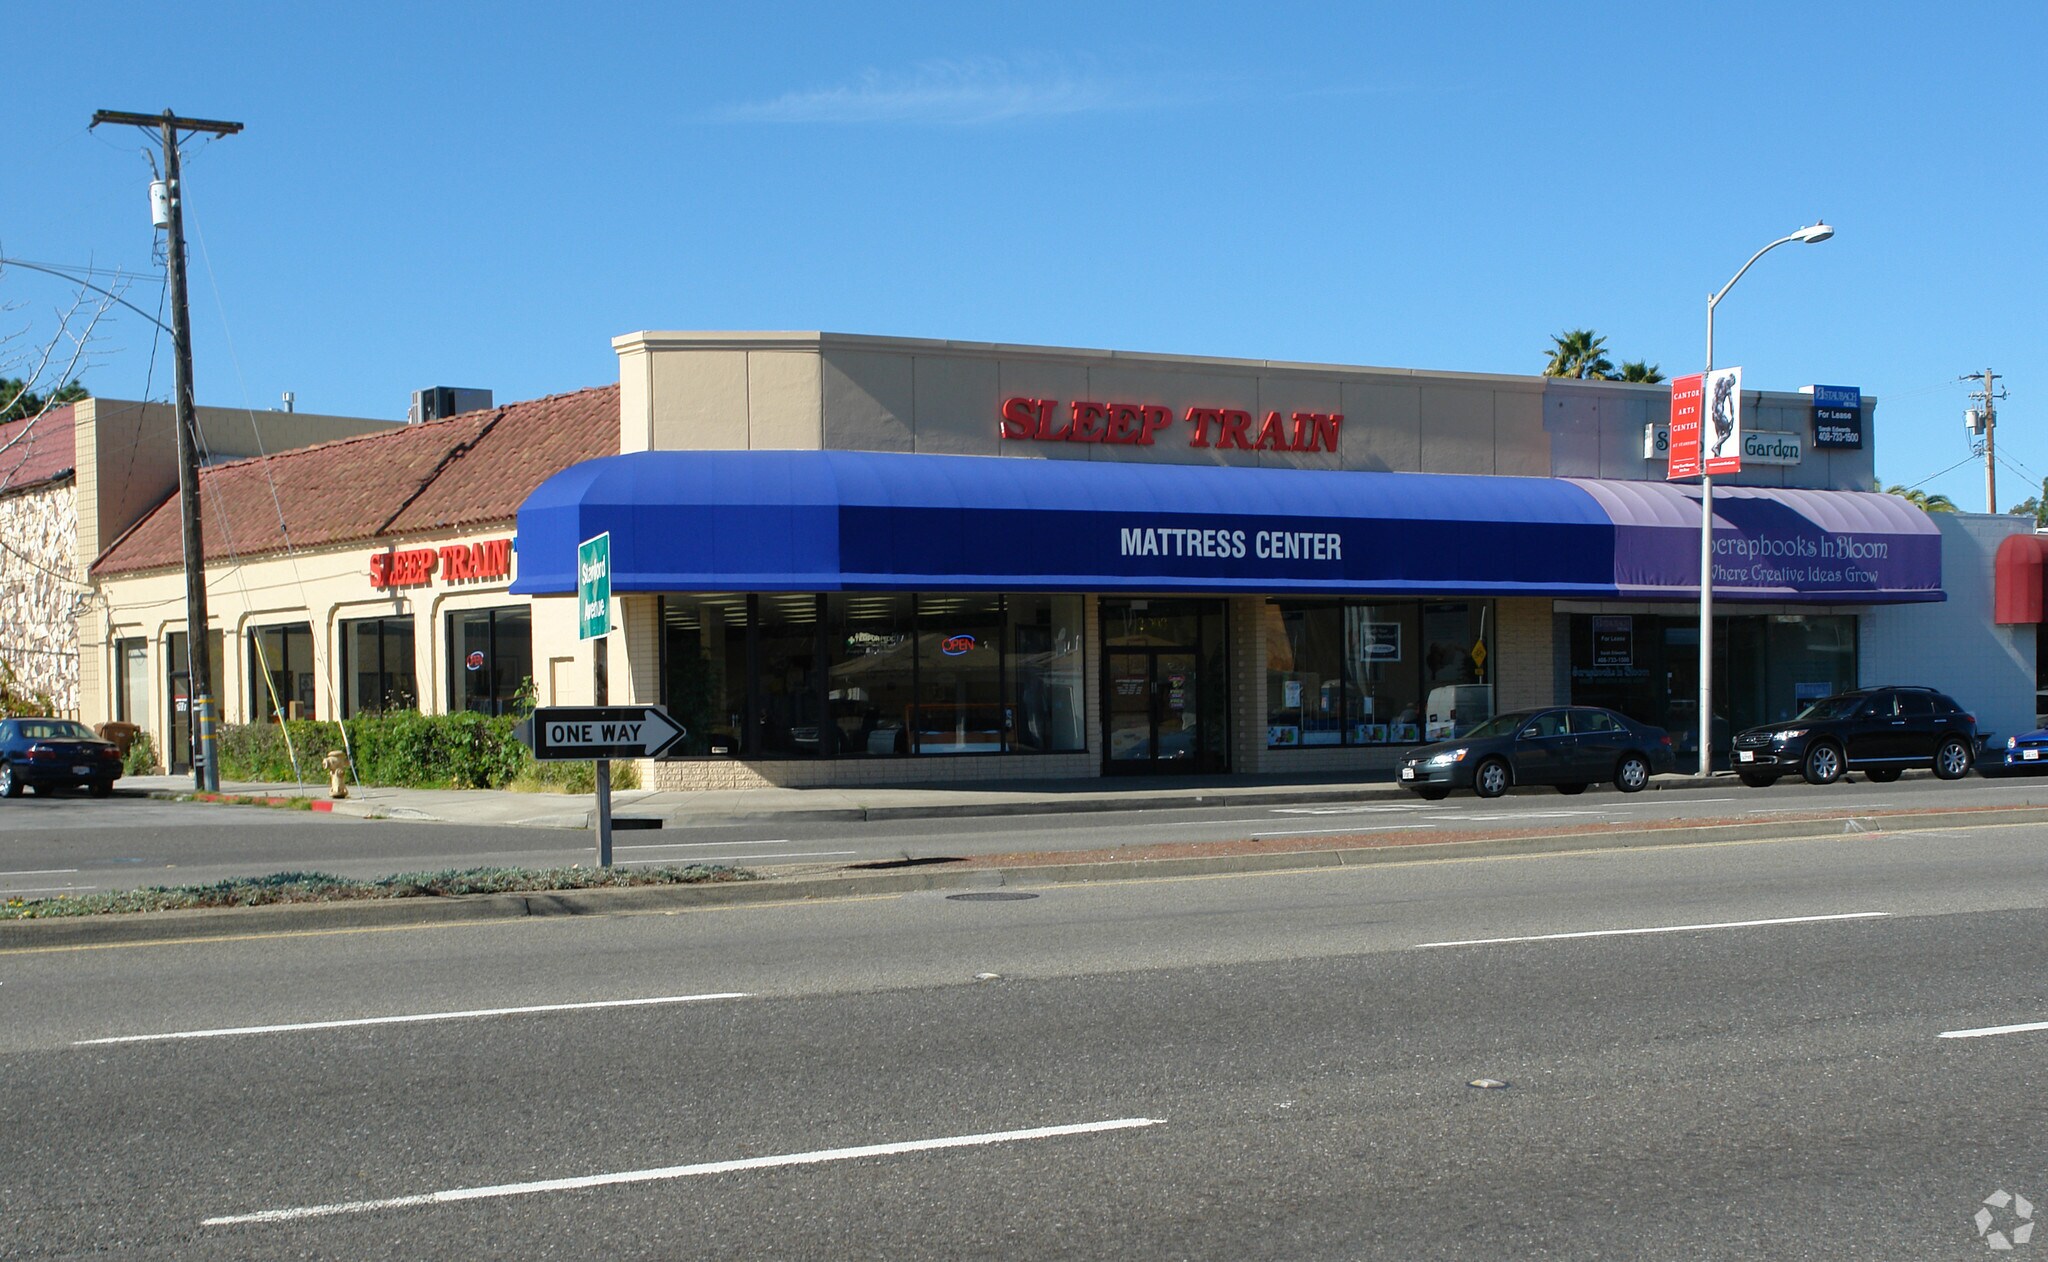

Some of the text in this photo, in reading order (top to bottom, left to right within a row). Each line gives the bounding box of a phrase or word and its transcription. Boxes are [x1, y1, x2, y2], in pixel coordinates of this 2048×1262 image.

[1673, 389, 1700, 400] CANTOR
[1678, 406, 1695, 415] ARTS
[1818, 410, 1852, 419] For Lease
[1001, 397, 1344, 453] SLEEP TRAIN
[1673, 421, 1698, 432] CENTER
[1745, 434, 1799, 459] Garden
[1120, 528, 1342, 560] MATTRESS CENTER
[1821, 535, 1834, 558] In
[1836, 535, 1888, 560] Bloom
[369, 538, 511, 588] SLEEP TRAIN
[582, 554, 606, 586] Stanford
[1751, 563, 1805, 583] Creative
[1808, 566, 1842, 583] Ideas
[1845, 567, 1879, 583] Grow
[584, 598, 605, 621] Avenue
[941, 638, 975, 651] OPEN
[552, 723, 642, 743] ONE WAY
